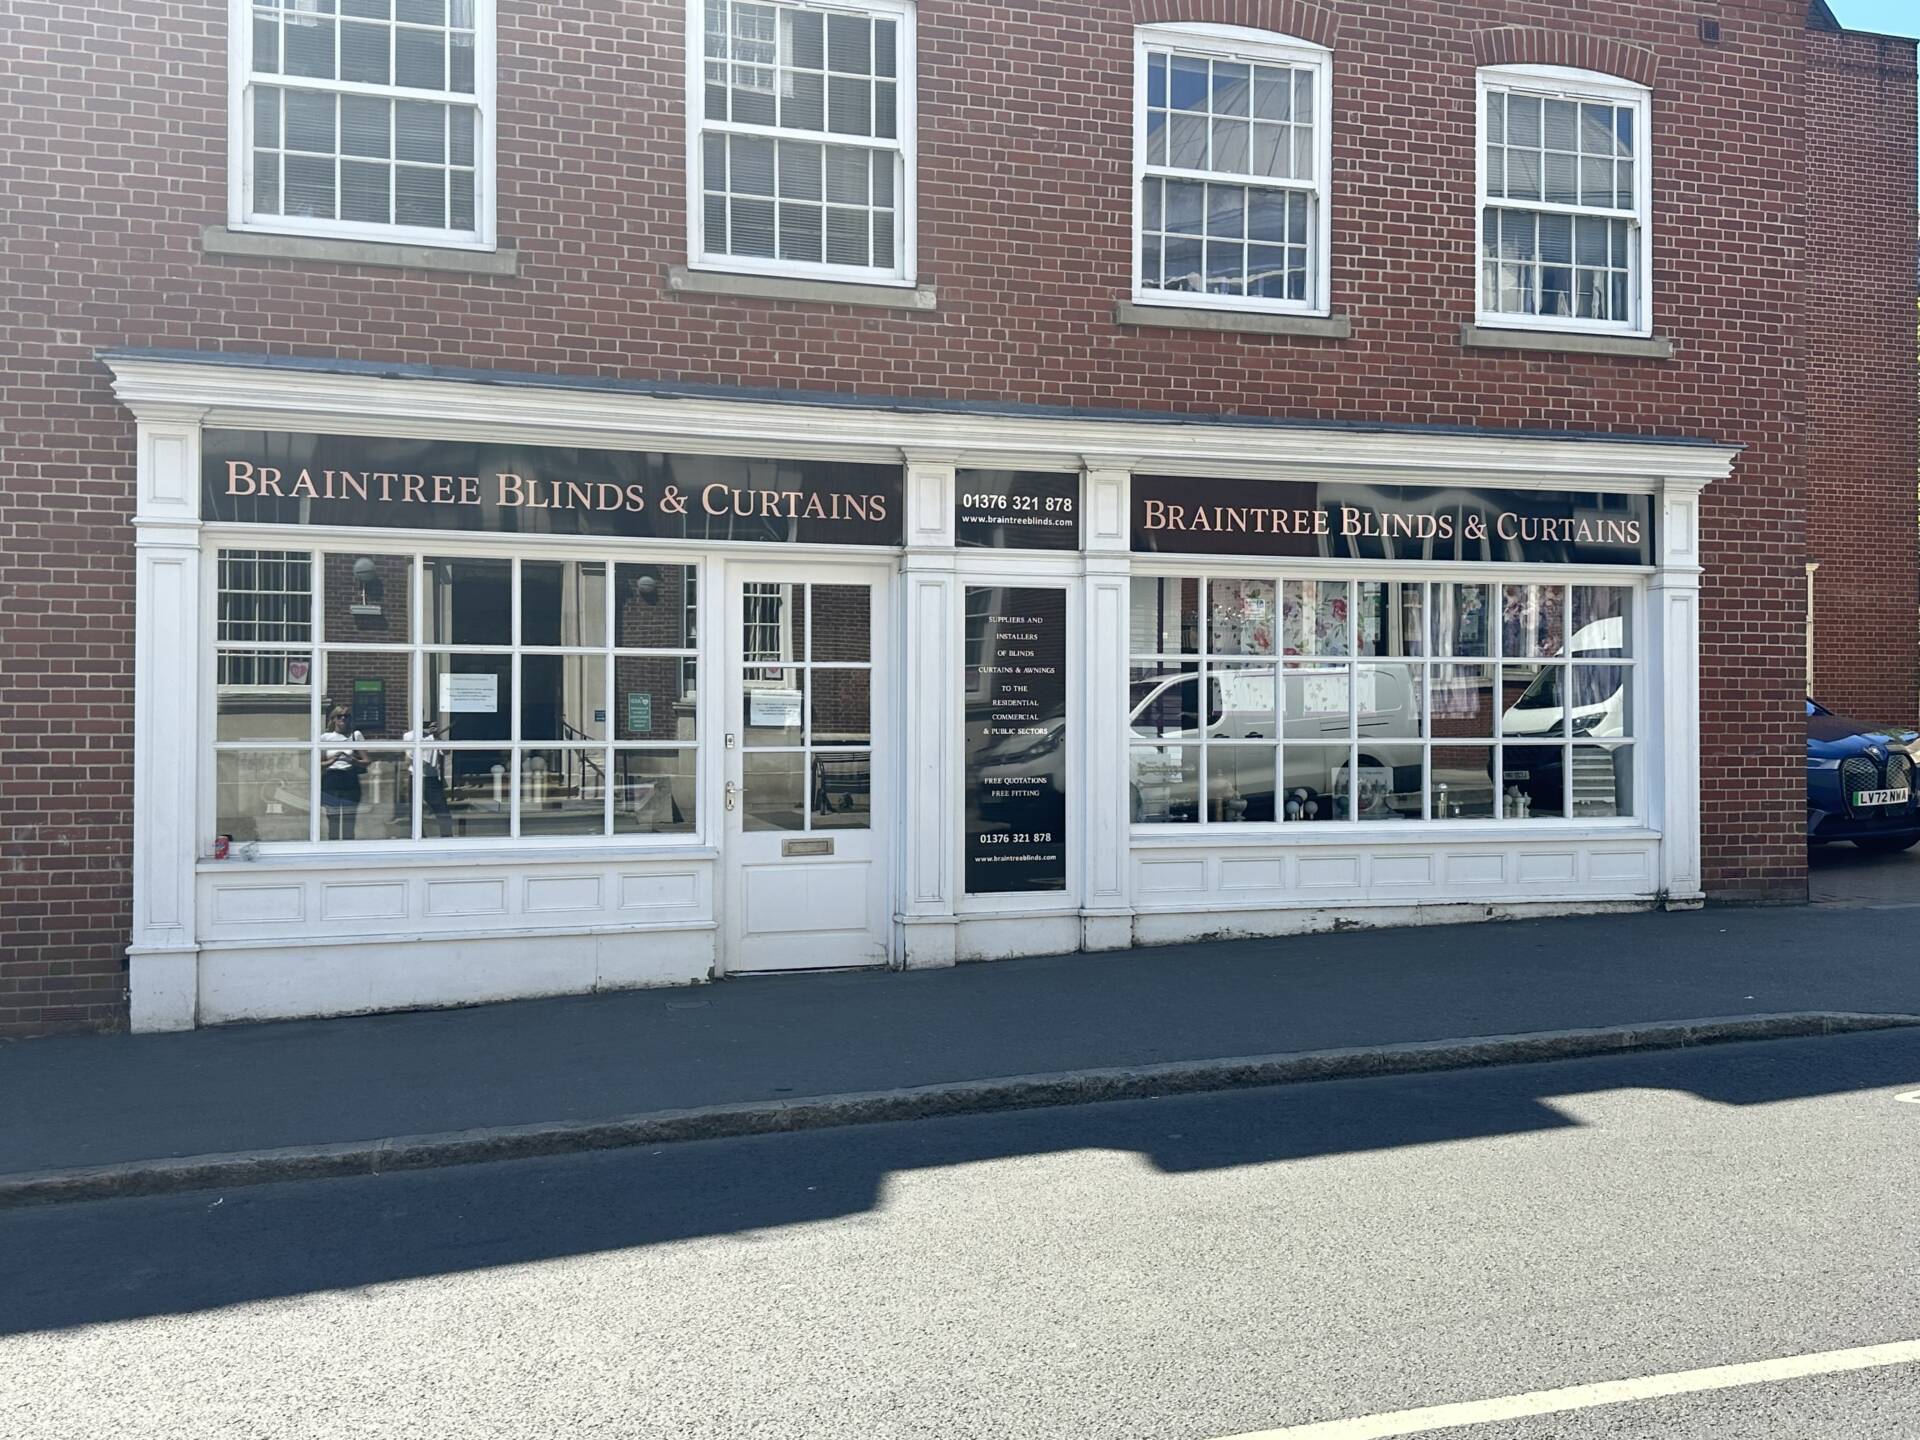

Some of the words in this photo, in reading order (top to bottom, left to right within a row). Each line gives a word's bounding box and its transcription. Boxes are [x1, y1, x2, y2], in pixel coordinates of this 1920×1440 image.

[225, 460, 481, 505] BRAINTREE
[496, 473, 644, 512] BLINDS
[659, 485, 688, 514] &
[702, 483, 887, 522] CURTAINS
[963, 494, 1007, 509] 01376
[1013, 496, 1039, 510] 321
[1045, 497, 1072, 512] 878
[962, 515, 1073, 527] www.braintreeblinds.com
[1144, 500, 1330, 535] BRAINTREE
[1340, 507, 1453, 539] BLINDS
[1464, 514, 1487, 541] &
[1497, 512, 1641, 544] CURTAINS
[988, 616, 1025, 624] SUPPLIERS
[984, 777, 1002, 785] FREE
[1004, 777, 1047, 785] QUOTATIONS
[1860, 792, 1888, 804] LV72
[1890, 790, 1907, 802] NWA
[980, 834, 1009, 844] 01376
[1012, 833, 1030, 843] 321
[1033, 833, 1051, 843] 878
[975, 854, 1056, 863] www.braintreeblinds.com
